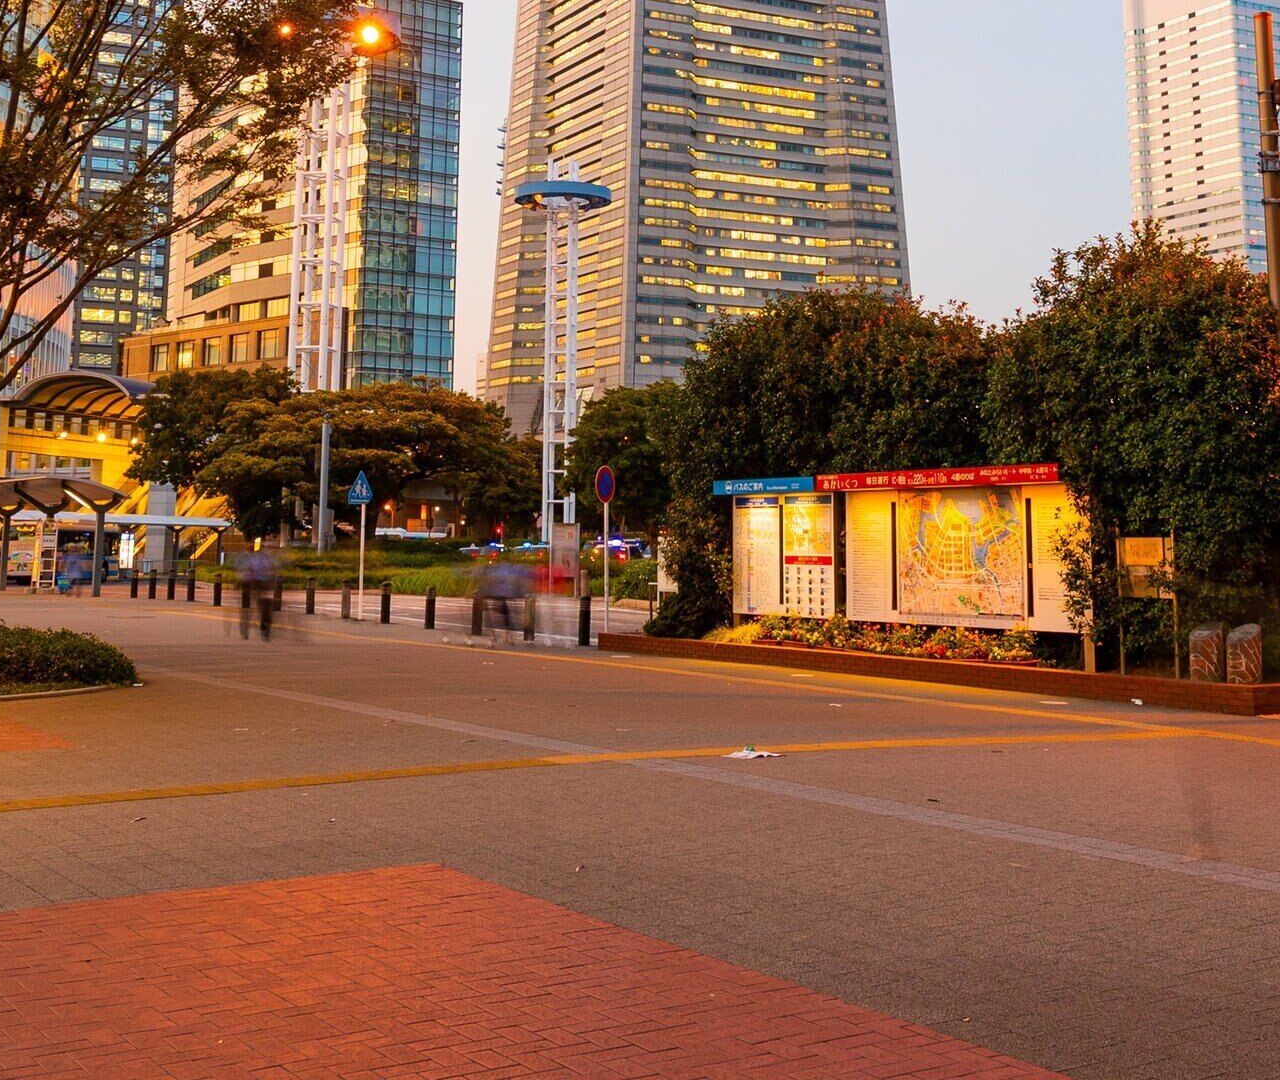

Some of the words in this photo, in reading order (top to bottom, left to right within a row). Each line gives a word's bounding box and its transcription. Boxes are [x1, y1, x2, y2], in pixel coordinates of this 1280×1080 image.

[733, 482, 764, 491] バスのご案内
[823, 479, 858, 489] あかいくつ
